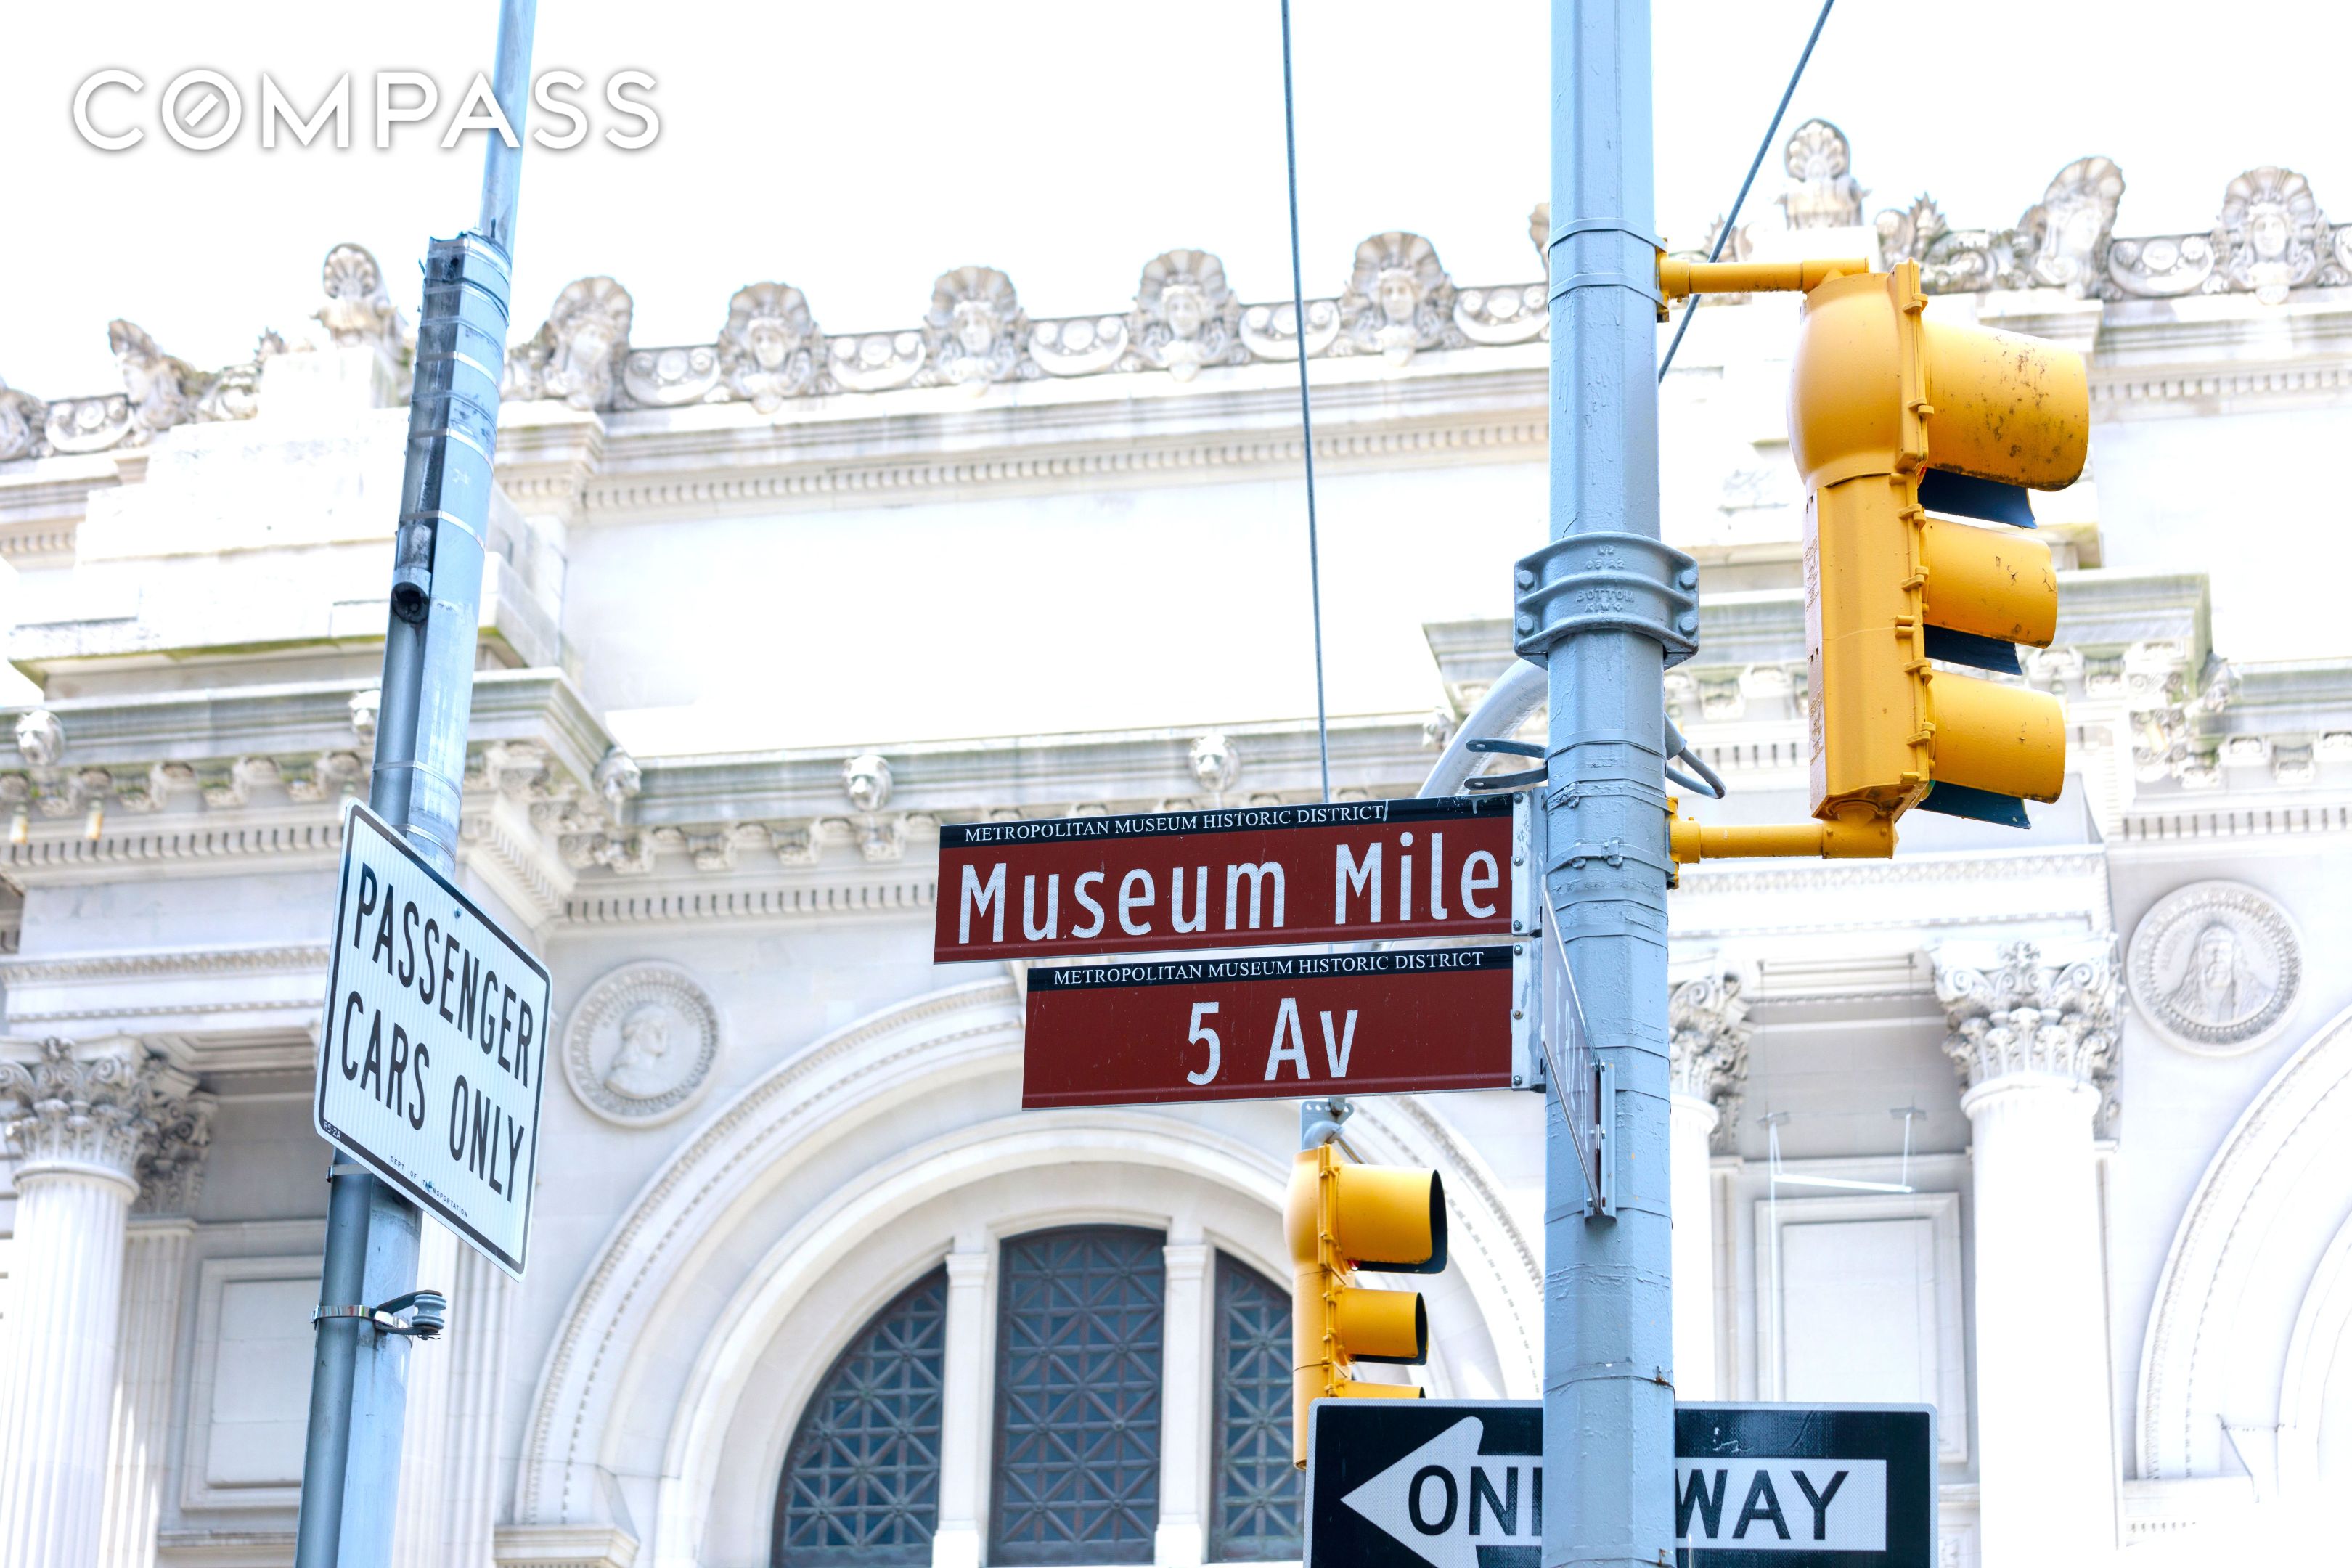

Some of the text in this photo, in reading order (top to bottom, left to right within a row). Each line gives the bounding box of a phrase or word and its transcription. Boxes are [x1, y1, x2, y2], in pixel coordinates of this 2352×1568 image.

[964, 805, 1384, 842] METROPOLITAN MUSEUM HISTORIC DISTRICT
[959, 831, 1500, 944] Museum Mile
[354, 862, 534, 1089] PASSENGER
[1054, 952, 1485, 985] METROPOLITAN MUSEUM HISTORIC DISTRICT
[1186, 997, 1358, 1085] 5 Av
[323, 1121, 341, 1140] R5-2A
[342, 990, 524, 1204] CARS ONLY
[390, 1156, 404, 1170] DEPT
[1408, 1464, 1850, 1540] ON WAY
